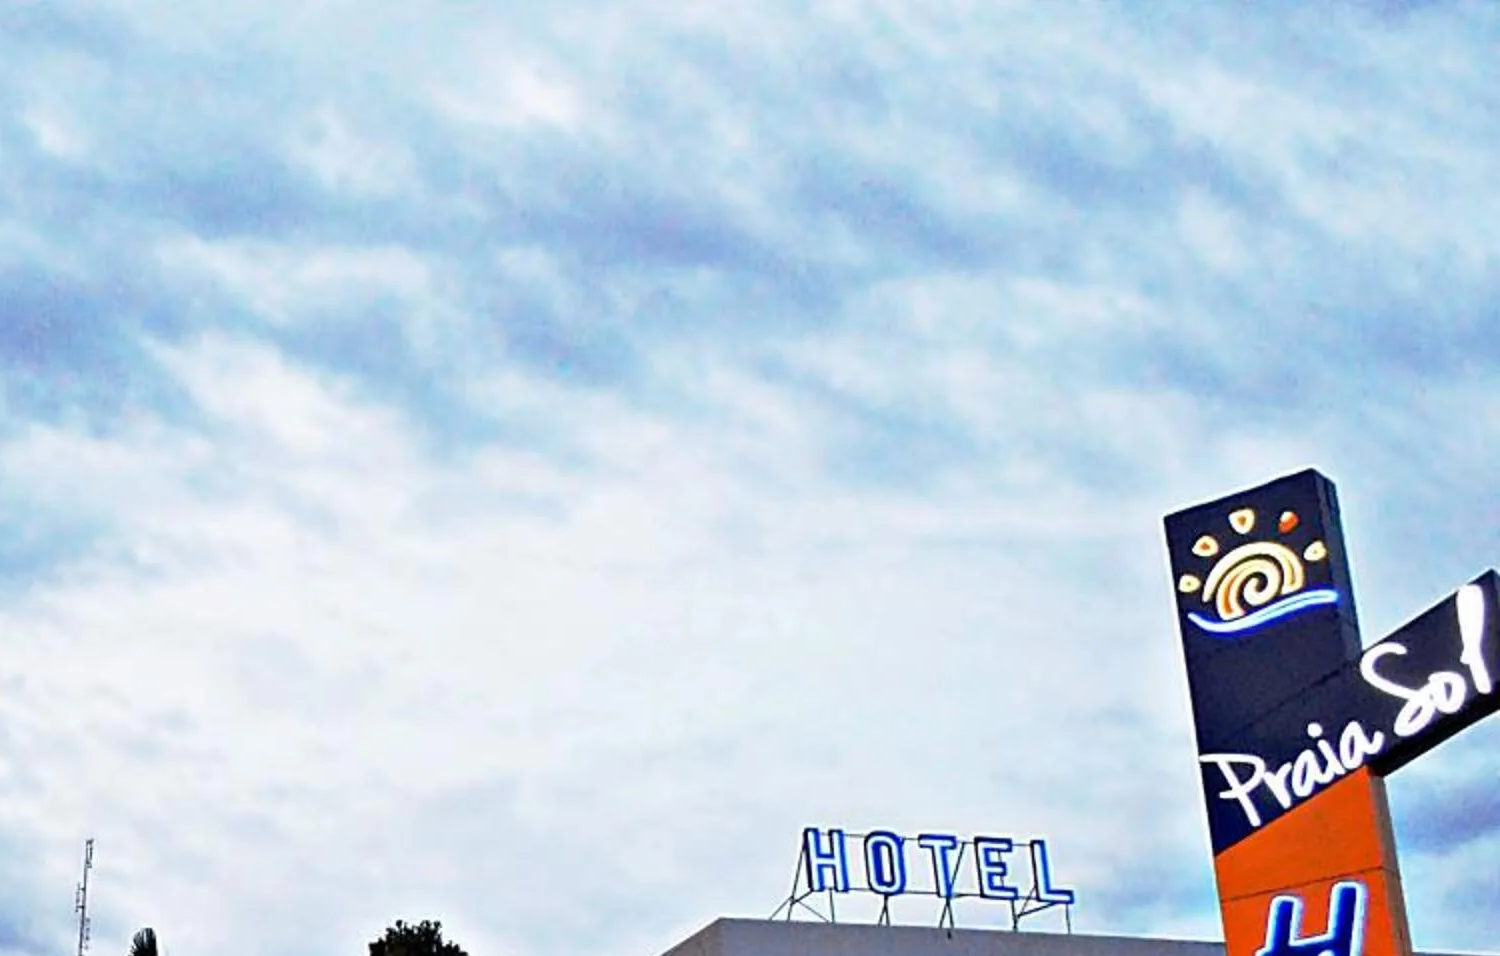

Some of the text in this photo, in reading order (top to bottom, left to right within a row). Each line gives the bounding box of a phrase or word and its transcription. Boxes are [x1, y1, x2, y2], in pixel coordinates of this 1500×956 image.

[1199, 584, 1493, 827] Praia Sol
[803, 827, 1075, 904] HOTEL
